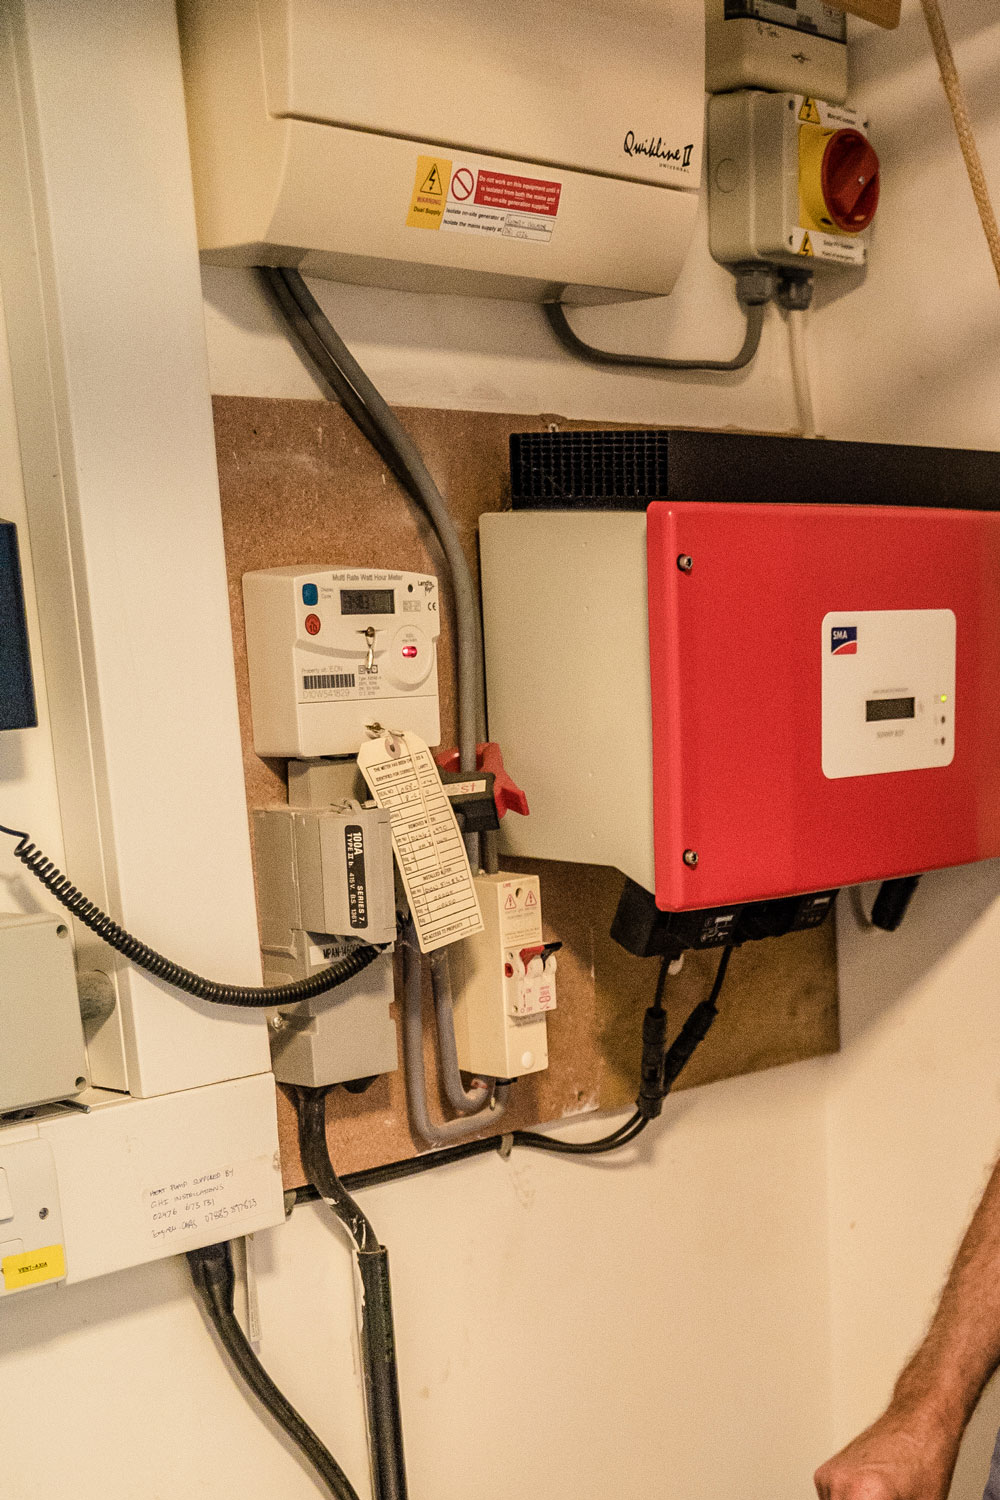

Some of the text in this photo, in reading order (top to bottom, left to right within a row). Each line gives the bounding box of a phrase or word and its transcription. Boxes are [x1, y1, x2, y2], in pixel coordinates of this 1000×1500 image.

[624, 130, 693, 167] Qwikline II
[425, 208, 441, 216] Supply
[833, 630, 848, 640] SMA
[353, 831, 364, 855] 100A
[225, 1168, 233, 1177] BY
[18, 1262, 48, 1274] VENT-AXIA
